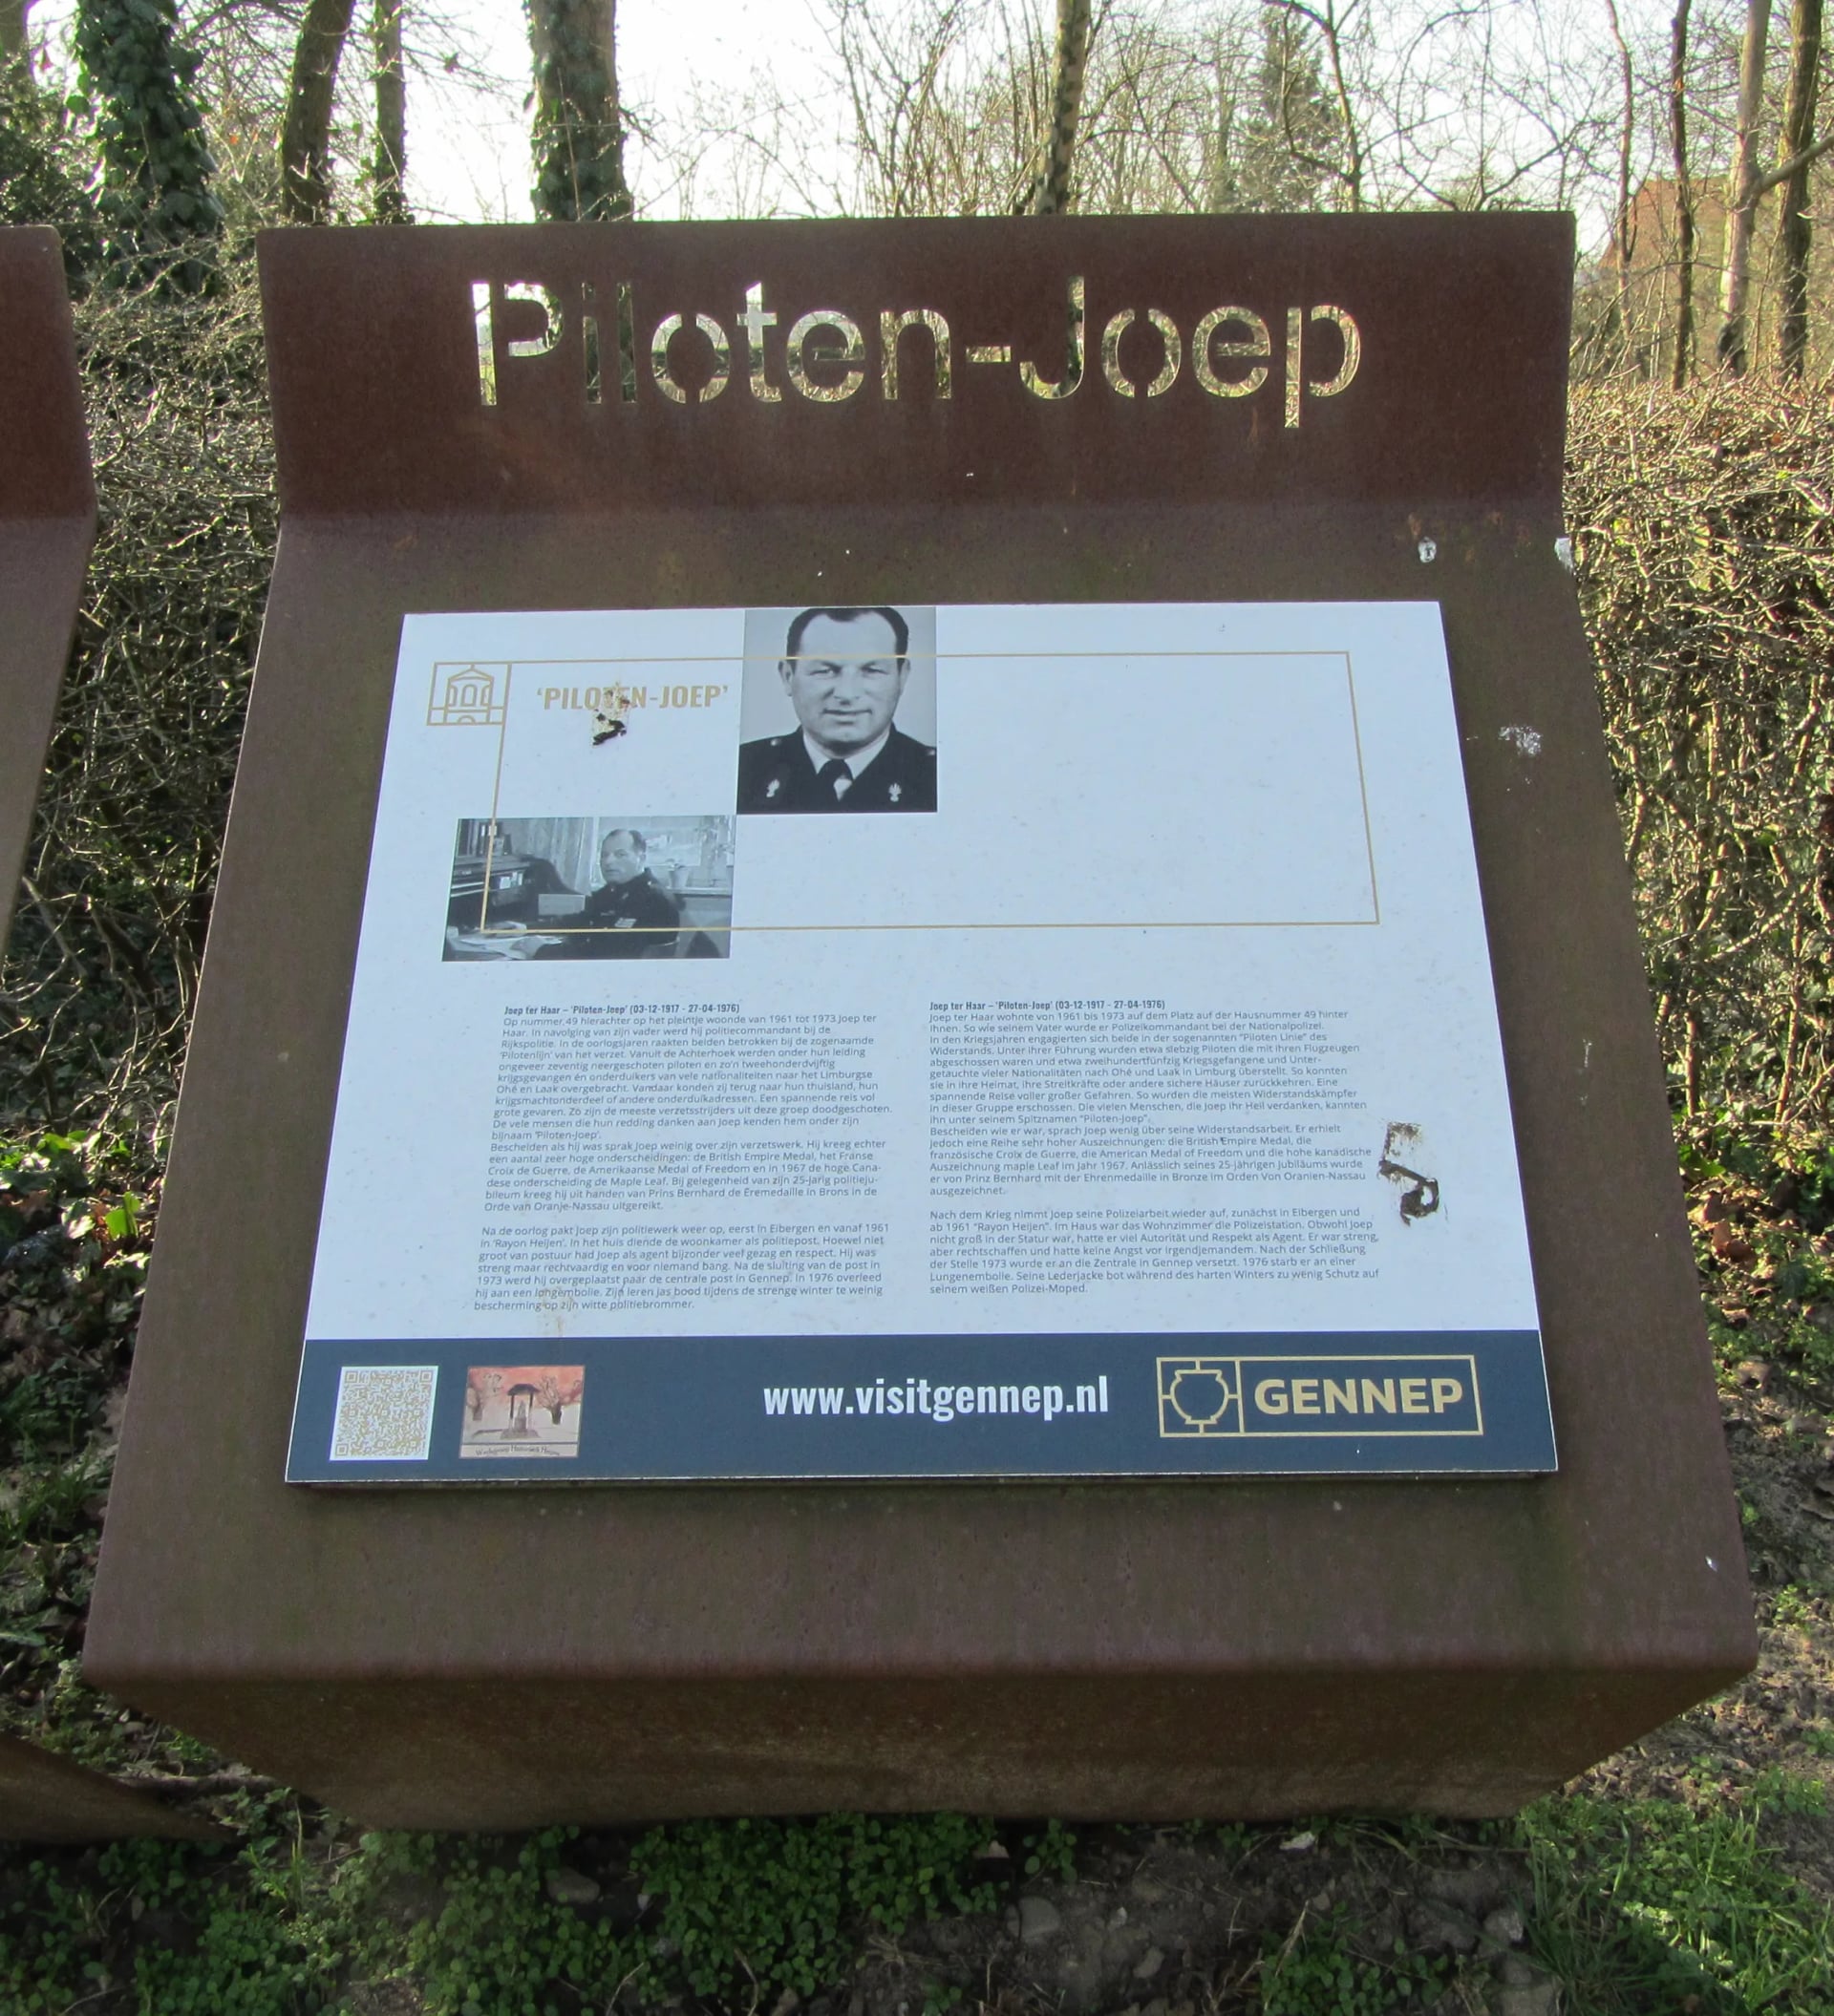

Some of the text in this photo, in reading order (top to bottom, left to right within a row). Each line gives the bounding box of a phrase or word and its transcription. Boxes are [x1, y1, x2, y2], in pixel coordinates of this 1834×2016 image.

[472, 276, 1360, 428] Piloten-Joep
[503, 1005, 523, 1016] Joep
[525, 1005, 538, 1014] ter
[540, 1005, 560, 1014] Haar
[929, 1001, 949, 1011] Joep
[950, 1001, 963, 1010] ter
[965, 1000, 986, 1009] Haar
[963, 1023, 975, 1032] So
[977, 1023, 995, 1032] wie
[997, 1023, 1034, 1032] seinem
[1035, 1022, 1062, 1031] Vater
[1064, 1022, 1096, 1031] wurde
[1111, 1021, 1209, 1031] Polizeikommandant
[1211, 1021, 1226, 1030] bei
[1228, 1021, 1246, 1030] der
[559, 1038, 568, 1048] In
[571, 1038, 584, 1048] de
[586, 1037, 649, 1050] oorlogsjaren
[650, 1037, 689, 1047] raakten
[691, 1037, 725, 1047] beiden
[727, 1036, 778, 1046] betrokken
[780, 1036, 793, 1048] bij
[795, 1036, 808, 1046] de
[810, 1035, 874, 1048] zogenaamde
[498, 1063, 544, 1072] ongeveer
[546, 1061, 588, 1072] zeventig
[590, 1060, 664, 1072] neergeschoten
[667, 1060, 701, 1072] piloten
[741, 1058, 835, 1071] tweehonderdvijftig
[929, 1056, 999, 1069] abgeschossen
[1035, 1056, 1056, 1066] und
[1057, 1057, 1081, 1066] etwa
[1084, 1055, 1181, 1068] zweihundertfünfzig
[1183, 1055, 1265, 1067] Kriegsgefangene
[1267, 1054, 1287, 1064] und
[498, 1072, 571, 1084] krijgsgevangen
[573, 1072, 586, 1081] én
[588, 1072, 655, 1081] onderduikers
[678, 1071, 698, 1080] vele
[701, 1071, 773, 1080] nationaliteiten
[800, 1070, 818, 1079] het
[820, 1070, 872, 1081] Limburgse
[495, 1094, 604, 1107] krijgsmachtonderdeel
[606, 1094, 618, 1104] of
[618, 1094, 654, 1104] andere
[759, 1093, 778, 1103] Een
[780, 1093, 837, 1105] spannende
[839, 1093, 858, 1102] reis
[860, 1093, 875, 1102] vol
[929, 1091, 986, 1103] spannende
[988, 1091, 1015, 1100] Reise
[1016, 1091, 1045, 1100] voller
[1047, 1091, 1081, 1102] großer
[1136, 1090, 1149, 1099] So
[1150, 1090, 1190, 1099] wurden
[1192, 1090, 1207, 1099] die
[1210, 1090, 1250, 1099] meisten
[1252, 1089, 1356, 1101] Widerstandskämpfer
[510, 1154, 542, 1163] aantal
[568, 1153, 594, 1164] hoge
[693, 1152, 706, 1161] de
[709, 1152, 741, 1161] British
[744, 1152, 779, 1163] Empire
[819, 1151, 836, 1160] het
[839, 1151, 873, 1160] Franse
[929, 1150, 993, 1159] französische
[995, 1150, 1022, 1158] Croix
[1024, 1149, 1037, 1158] de
[1080, 1149, 1097, 1158] die
[1099, 1149, 1147, 1158] American
[1150, 1148, 1182, 1157] Medal
[1184, 1148, 1195, 1157] of
[1197, 1148, 1243, 1157] Freedom
[1245, 1148, 1266, 1157] und
[1268, 1148, 1283, 1157] die
[1286, 1148, 1312, 1157] hohe
[1314, 1147, 1372, 1157] kanadische
[929, 1246, 953, 1256] aber
[956, 1246, 1027, 1256] rechtschaffen
[1030, 1246, 1050, 1256] und
[1053, 1246, 1080, 1255] hatte
[1082, 1245, 1111, 1255] keine
[1113, 1245, 1142, 1257] Angst
[1259, 1244, 1286, 1254] Nach
[1289, 1244, 1306, 1254] der
[1309, 1244, 1366, 1256] Schließung
[478, 1263, 511, 1275] streng
[544, 1263, 608, 1274] rechtvaardig
[652, 1262, 699, 1271] niemand
[734, 1261, 748, 1270] Na
[751, 1261, 764, 1270] de
[766, 1261, 804, 1272] sluiting
[828, 1261, 842, 1270] de
[844, 1261, 867, 1272] post
[870, 1260, 880, 1269] in
[1015, 1271, 1045, 1281] Seine
[1047, 1270, 1103, 1283] Lederjacke
[1105, 1270, 1124, 1280] bot
[1126, 1270, 1173, 1280] während
[1175, 1270, 1194, 1280] des
[1196, 1270, 1231, 1279] harten
[1233, 1269, 1274, 1279] Winters
[1290, 1269, 1323, 1281] wenig
[1325, 1269, 1359, 1279] Schutz
[1362, 1269, 1379, 1278] auf
[929, 1284, 968, 1294] seinem
[970, 1284, 1008, 1294] weißen
[473, 1301, 542, 1312] bescherming
[542, 1303, 558, 1312] op
[560, 1300, 579, 1311] zijn
[581, 1300, 607, 1309] witte
[764, 1375, 1108, 1421] www.visitgennep.nl
[1254, 1378, 1462, 1414] GENNEP
